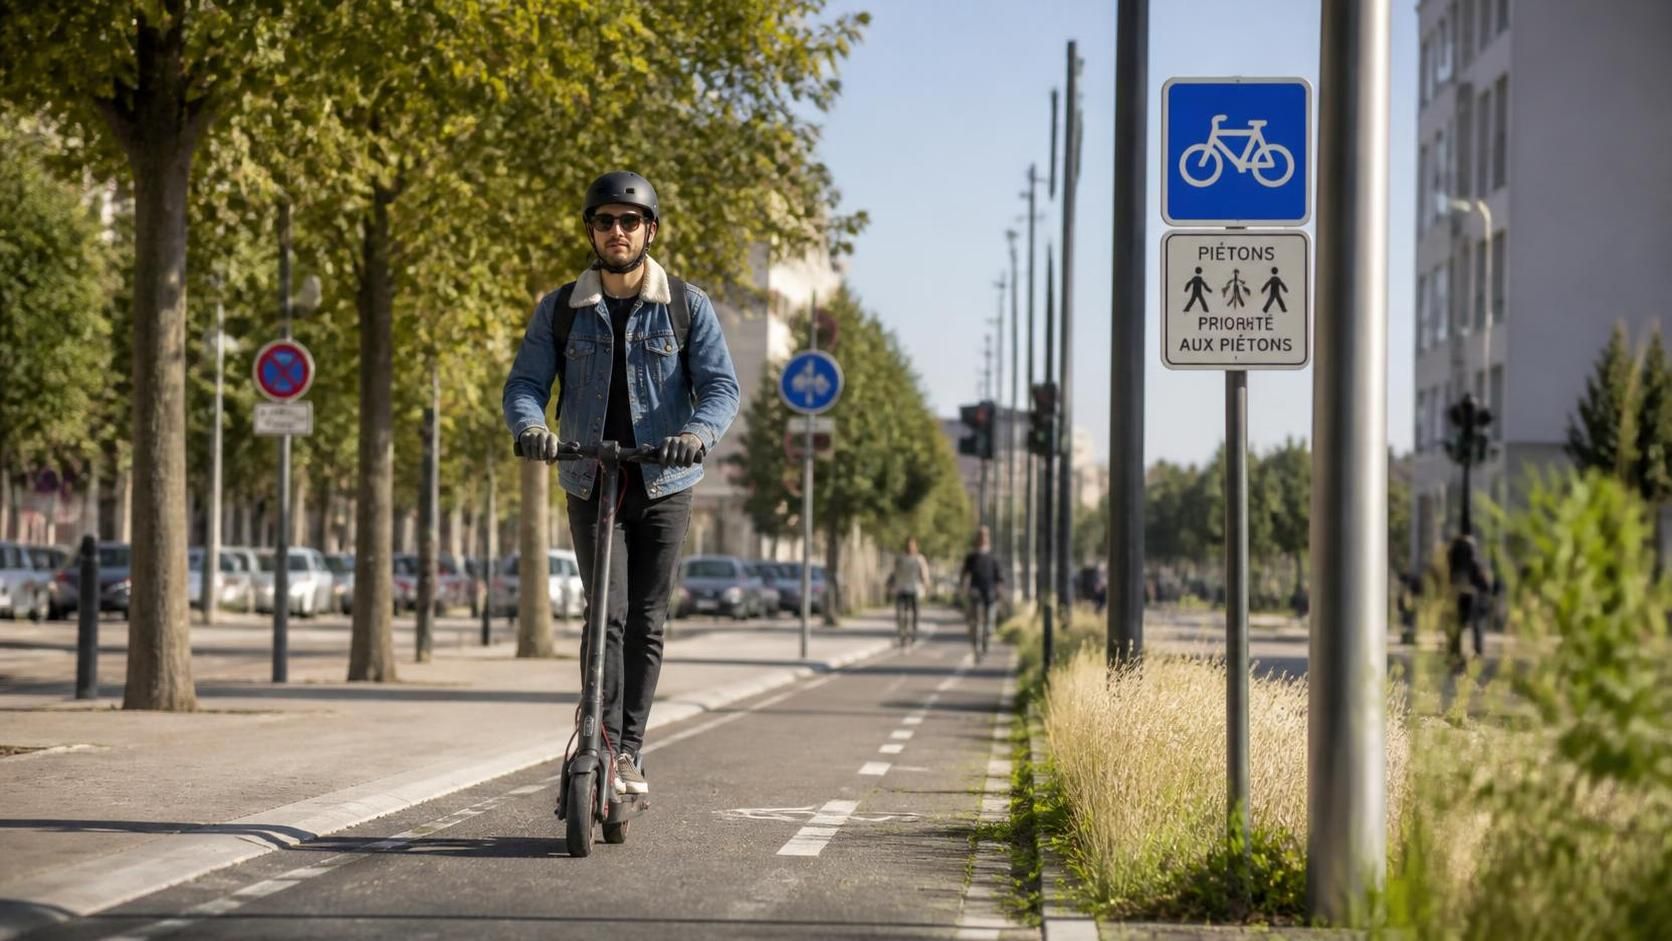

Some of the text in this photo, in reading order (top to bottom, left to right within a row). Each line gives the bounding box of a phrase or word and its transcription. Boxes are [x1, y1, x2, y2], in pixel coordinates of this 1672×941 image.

[1198, 242, 1275, 261] PIÉTONS
[1179, 334, 1292, 352] AUX PIÉTONS
